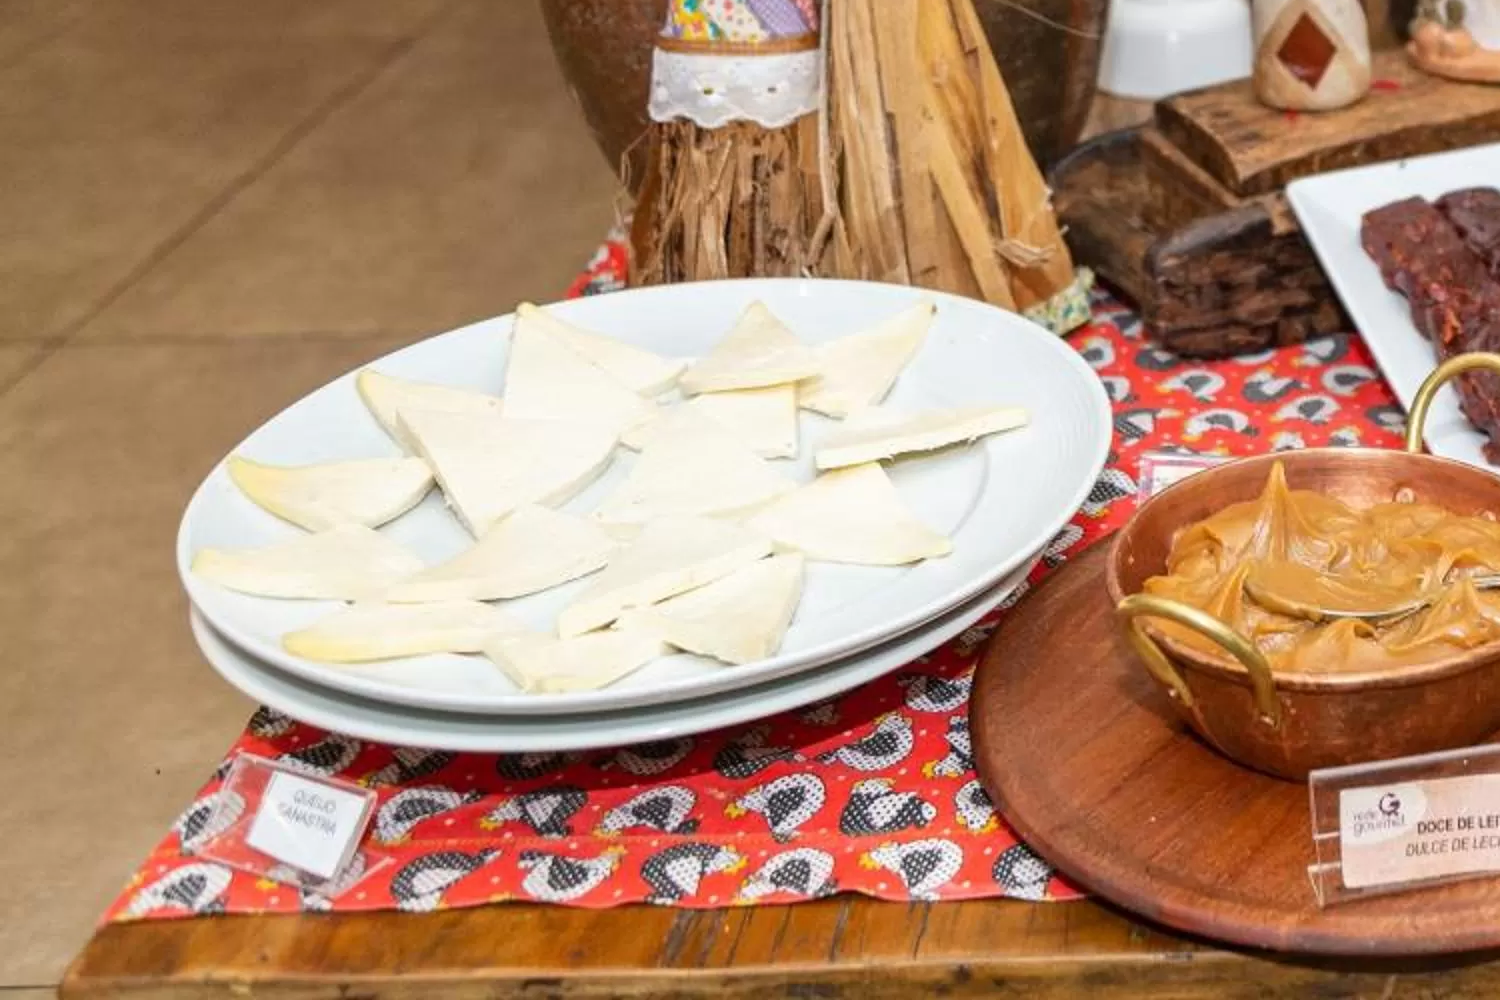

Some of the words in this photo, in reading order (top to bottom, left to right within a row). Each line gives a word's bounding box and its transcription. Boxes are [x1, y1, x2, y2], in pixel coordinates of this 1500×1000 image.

[1417, 816, 1454, 835] DOCE
[1456, 815, 1475, 831] DE
[1405, 839, 1449, 857] DULCE
[1451, 836, 1469, 853] DE
